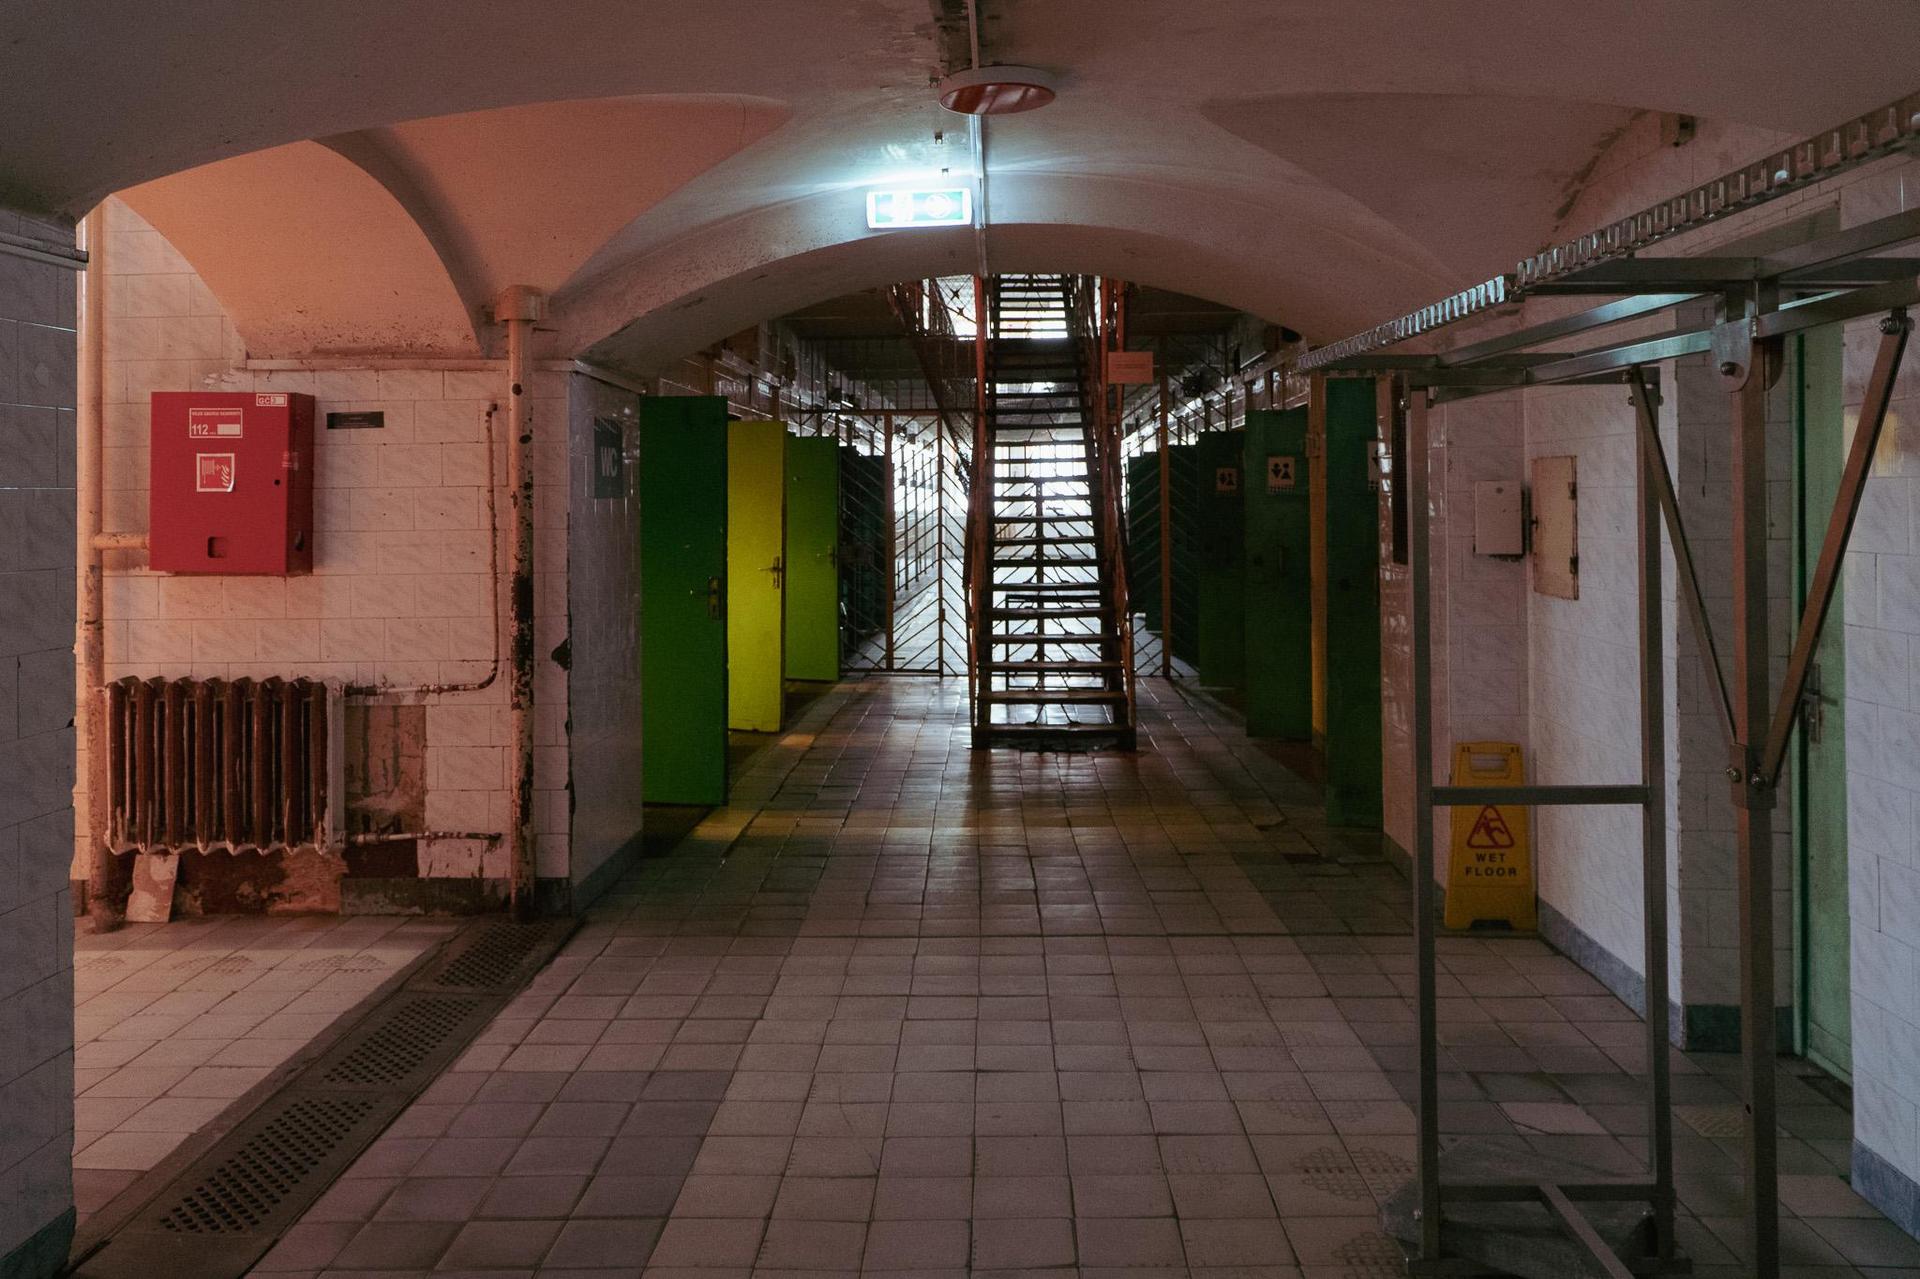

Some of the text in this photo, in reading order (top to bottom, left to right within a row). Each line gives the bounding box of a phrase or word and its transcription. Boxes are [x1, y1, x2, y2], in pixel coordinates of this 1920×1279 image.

[192, 424, 209, 435] 112
[600, 447, 618, 477] WC
[1475, 853, 1506, 863] WET
[1465, 867, 1518, 877] FLOOR
